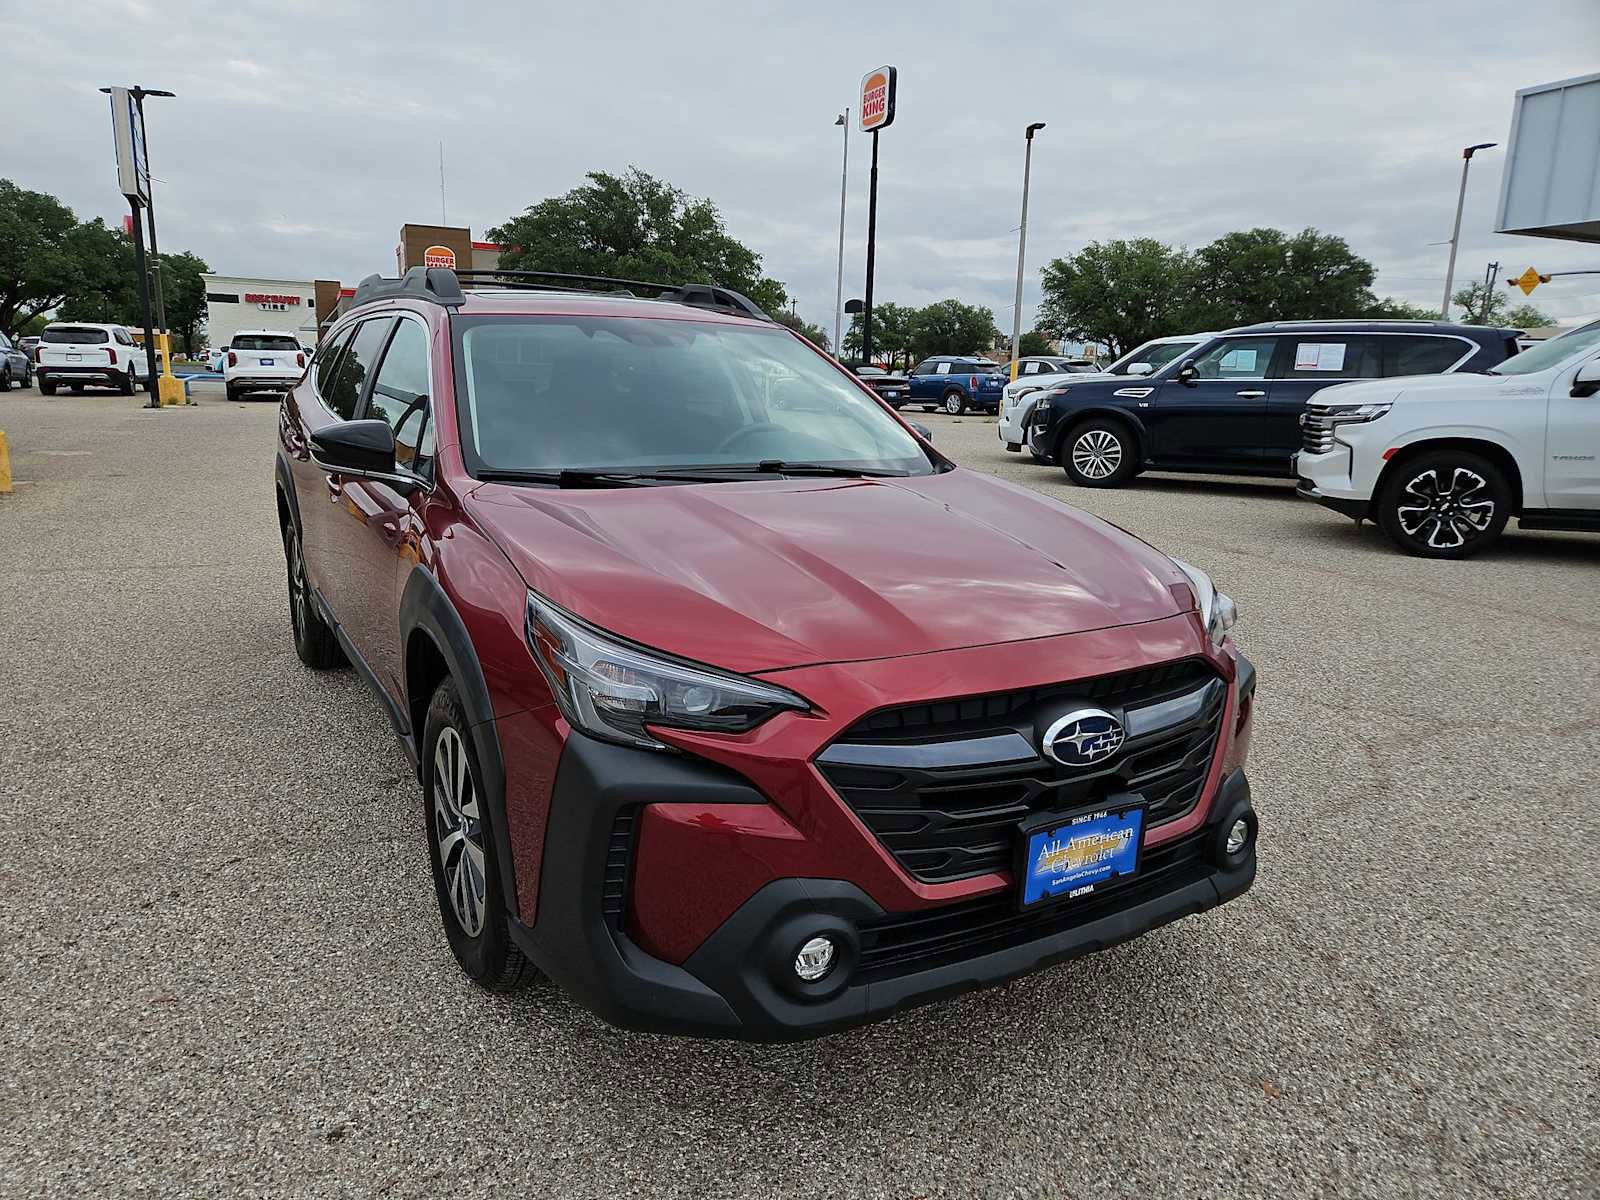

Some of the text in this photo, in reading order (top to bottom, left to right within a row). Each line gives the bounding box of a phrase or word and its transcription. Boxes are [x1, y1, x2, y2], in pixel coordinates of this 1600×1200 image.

[863, 86, 886, 103] BURGER
[863, 97, 885, 118] KING
[425, 256, 455, 264] BURGER
[245, 293, 301, 304] DISCOUNT
[1071, 814, 1092, 826] SINCE
[1038, 827, 1134, 861] All American
[1051, 846, 1115, 873] Chevrolet
